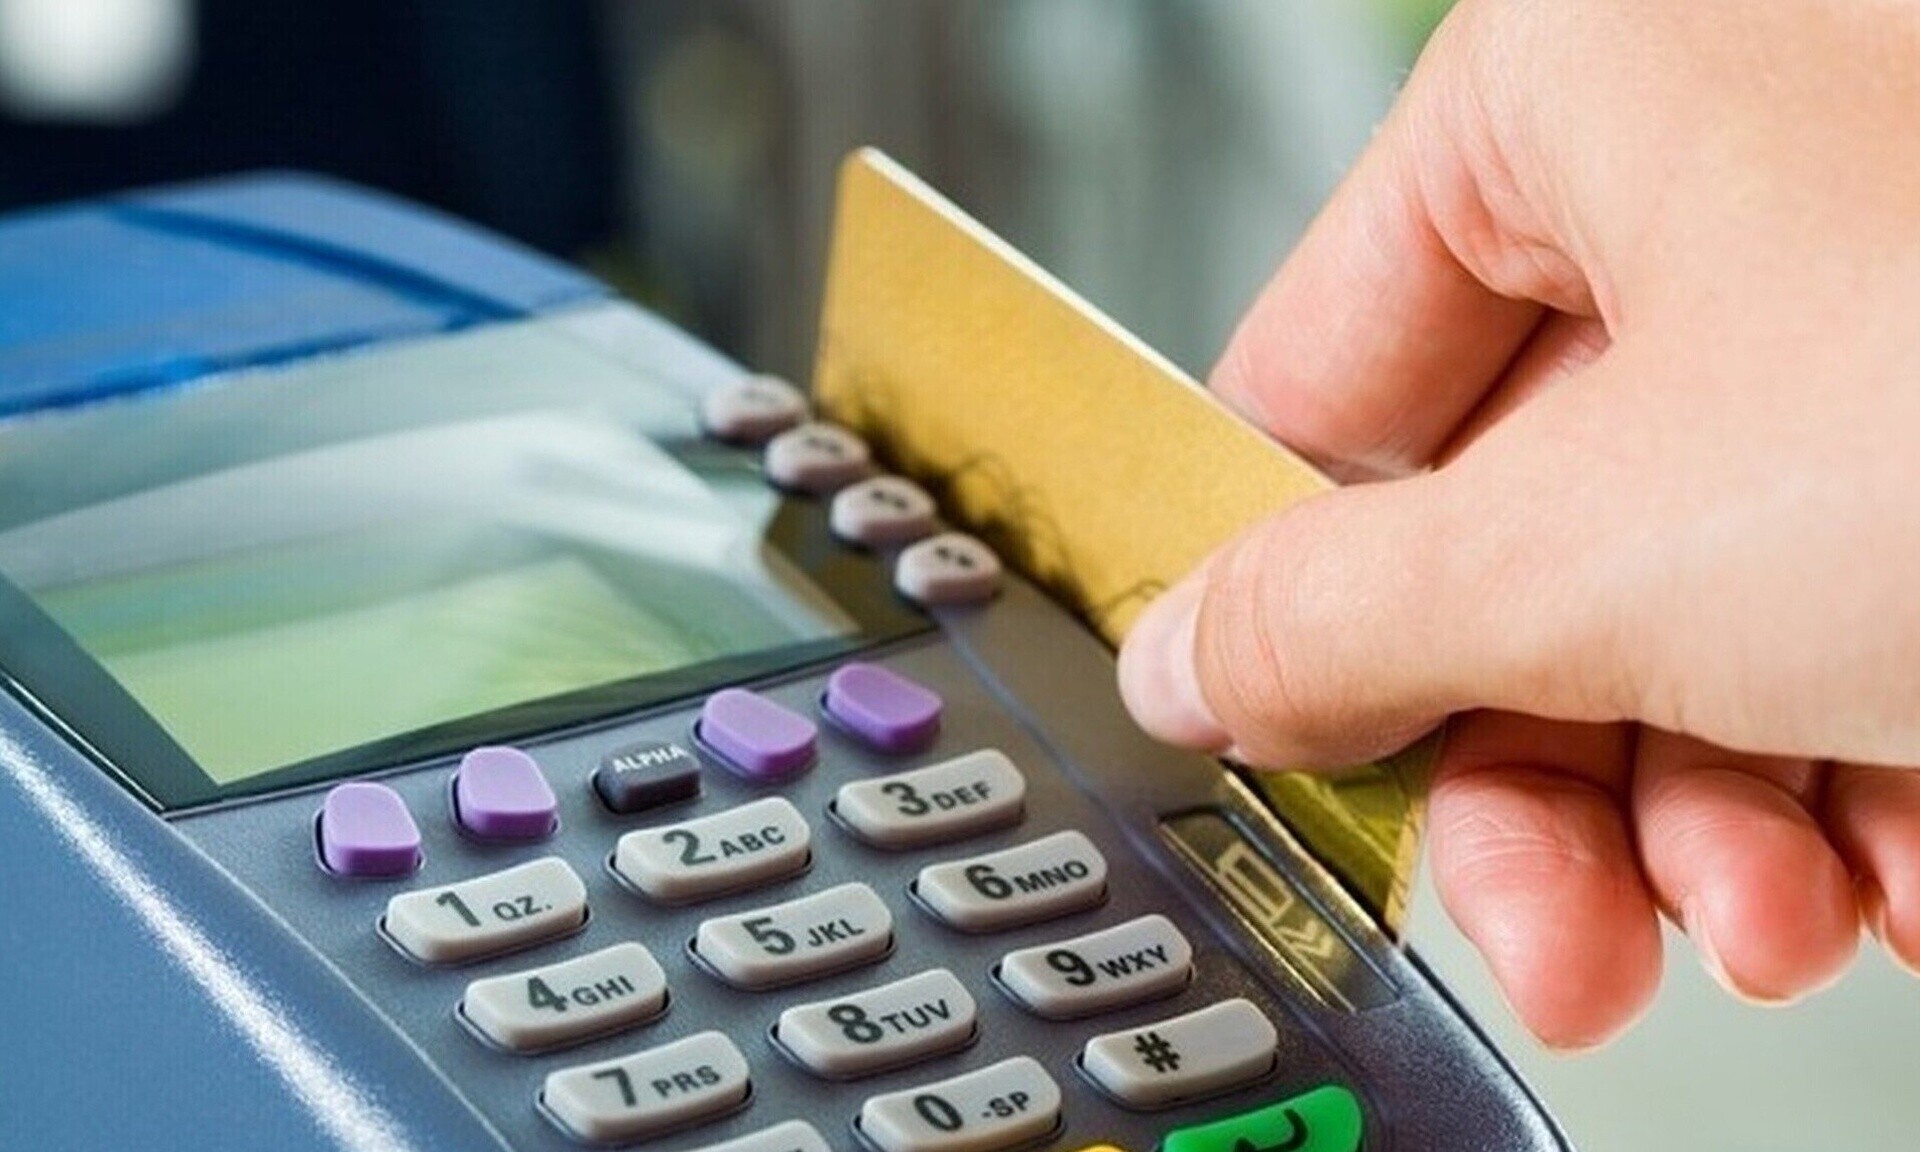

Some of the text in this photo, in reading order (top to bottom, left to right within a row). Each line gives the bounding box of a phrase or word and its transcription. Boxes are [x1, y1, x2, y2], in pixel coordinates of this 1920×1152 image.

[612, 743, 689, 773] ALPHA
[882, 780, 992, 817] 3 DEF
[662, 825, 786, 866] 2 ABC
[965, 860, 1089, 900] 6 MNO
[436, 891, 481, 927] 1
[742, 917, 865, 956] 5 JKL
[1046, 944, 1170, 987] 9 WXY
[526, 974, 636, 1013] 4 GHI
[827, 998, 952, 1044] 8 TUV
[1134, 1031, 1181, 1073] #
[593, 1064, 722, 1107] 7 PRS
[914, 1094, 963, 1132] 0
